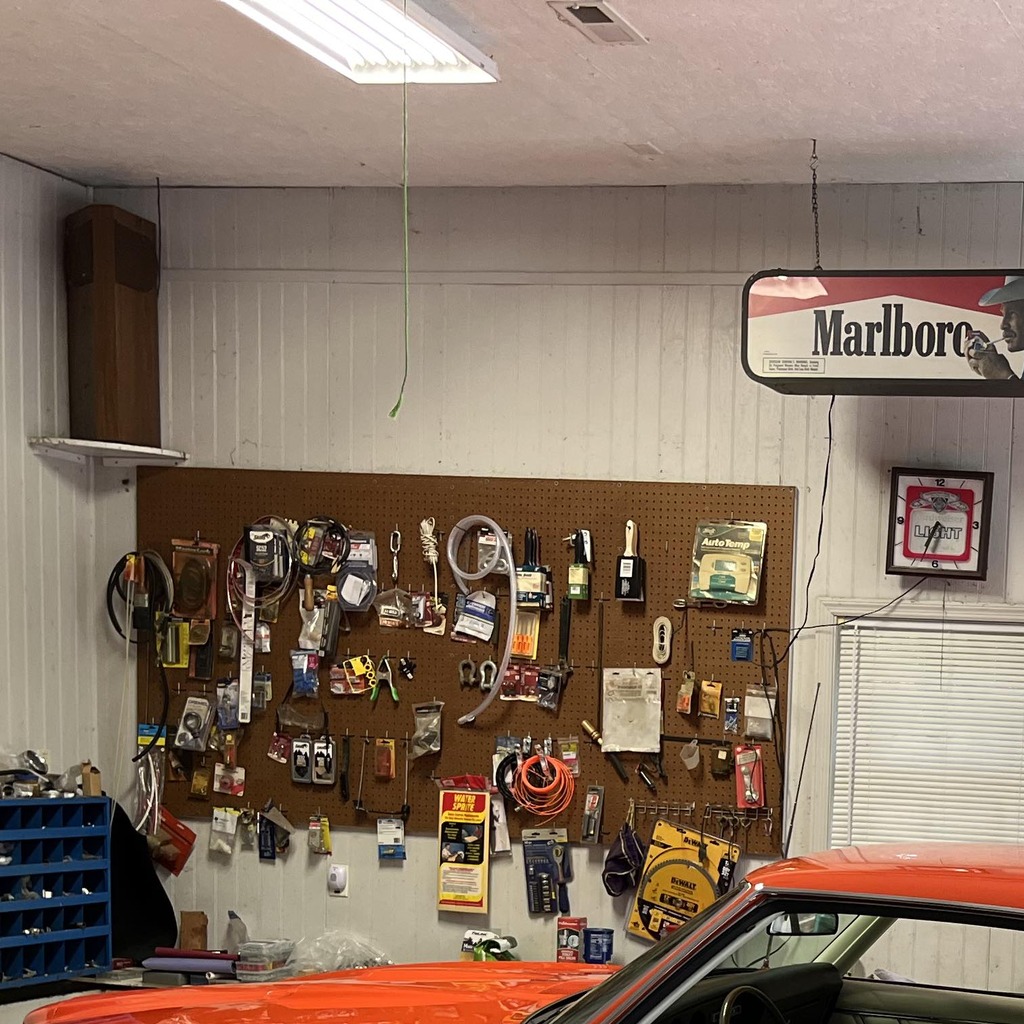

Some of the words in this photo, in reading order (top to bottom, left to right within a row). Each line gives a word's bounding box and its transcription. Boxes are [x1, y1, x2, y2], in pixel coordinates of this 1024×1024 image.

[812, 304, 973, 357] Marlboro
[934, 479, 945, 487] 12
[897, 516, 905, 525] 9
[972, 521, 980, 530] 3
[931, 560, 939, 568] 6
[453, 793, 476, 803] WATER
[452, 802, 475, 811] SPRITE
